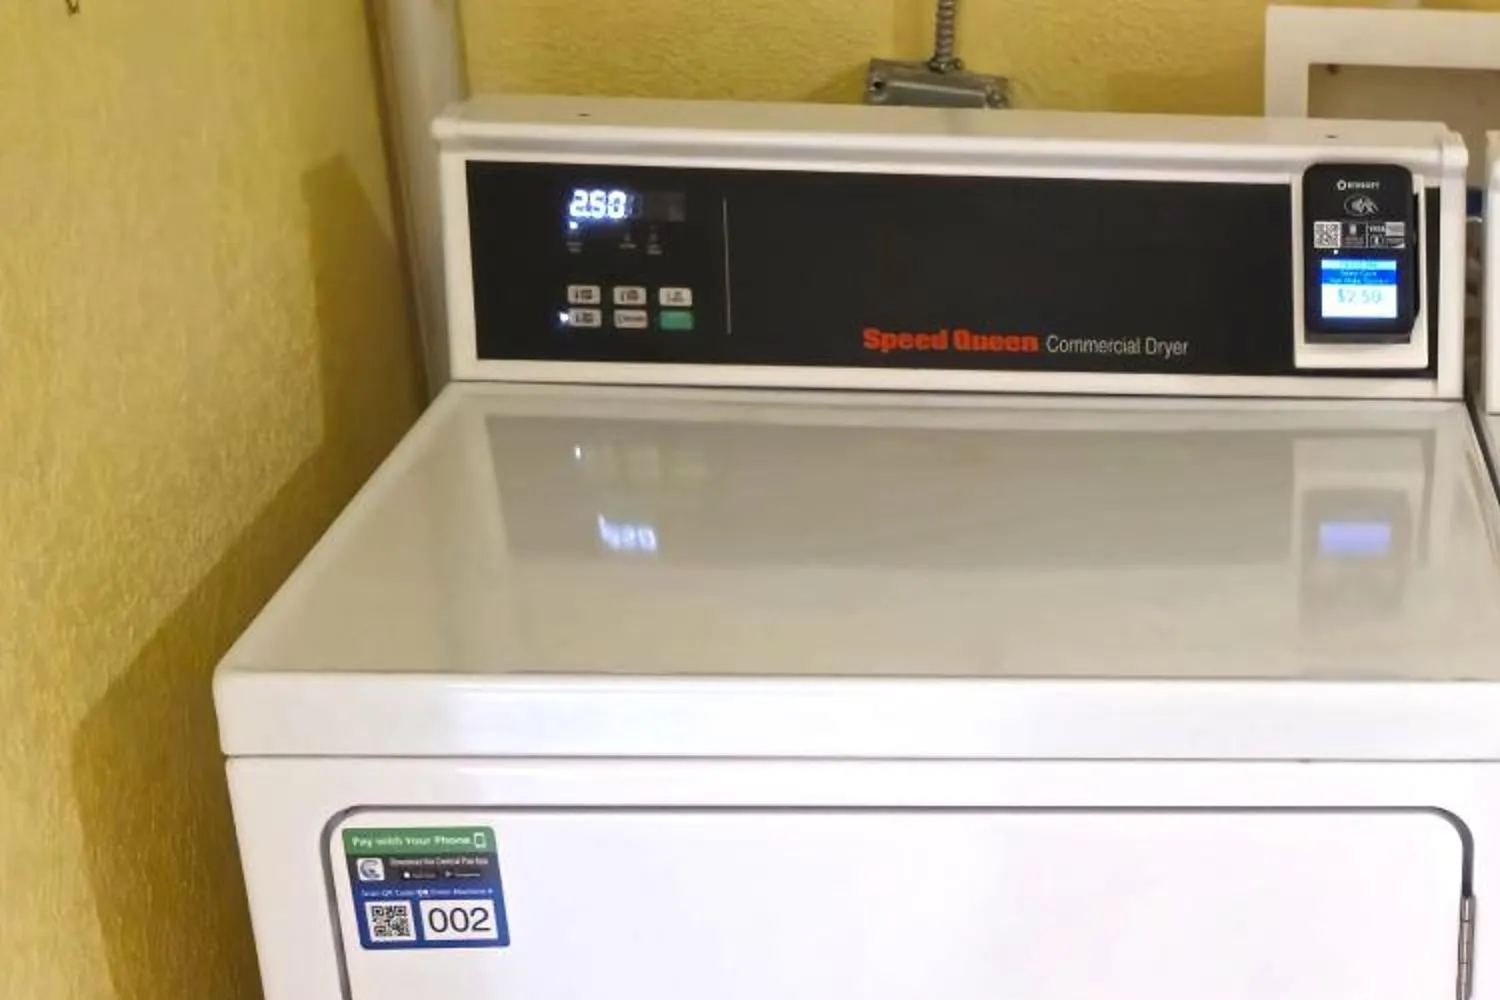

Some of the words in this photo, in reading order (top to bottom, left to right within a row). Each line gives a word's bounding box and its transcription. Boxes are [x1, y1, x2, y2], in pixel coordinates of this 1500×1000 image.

[568, 189, 628, 219] 2.50
[863, 327, 948, 353] Speed
[953, 329, 1039, 352] Queen
[1046, 334, 1141, 355] Commercial
[1146, 336, 1189, 359] Dryer
[351, 836, 373, 849] Pay
[377, 835, 403, 846] with
[405, 834, 431, 846] Your
[435, 834, 472, 845] Phone
[428, 907, 492, 933] 002
